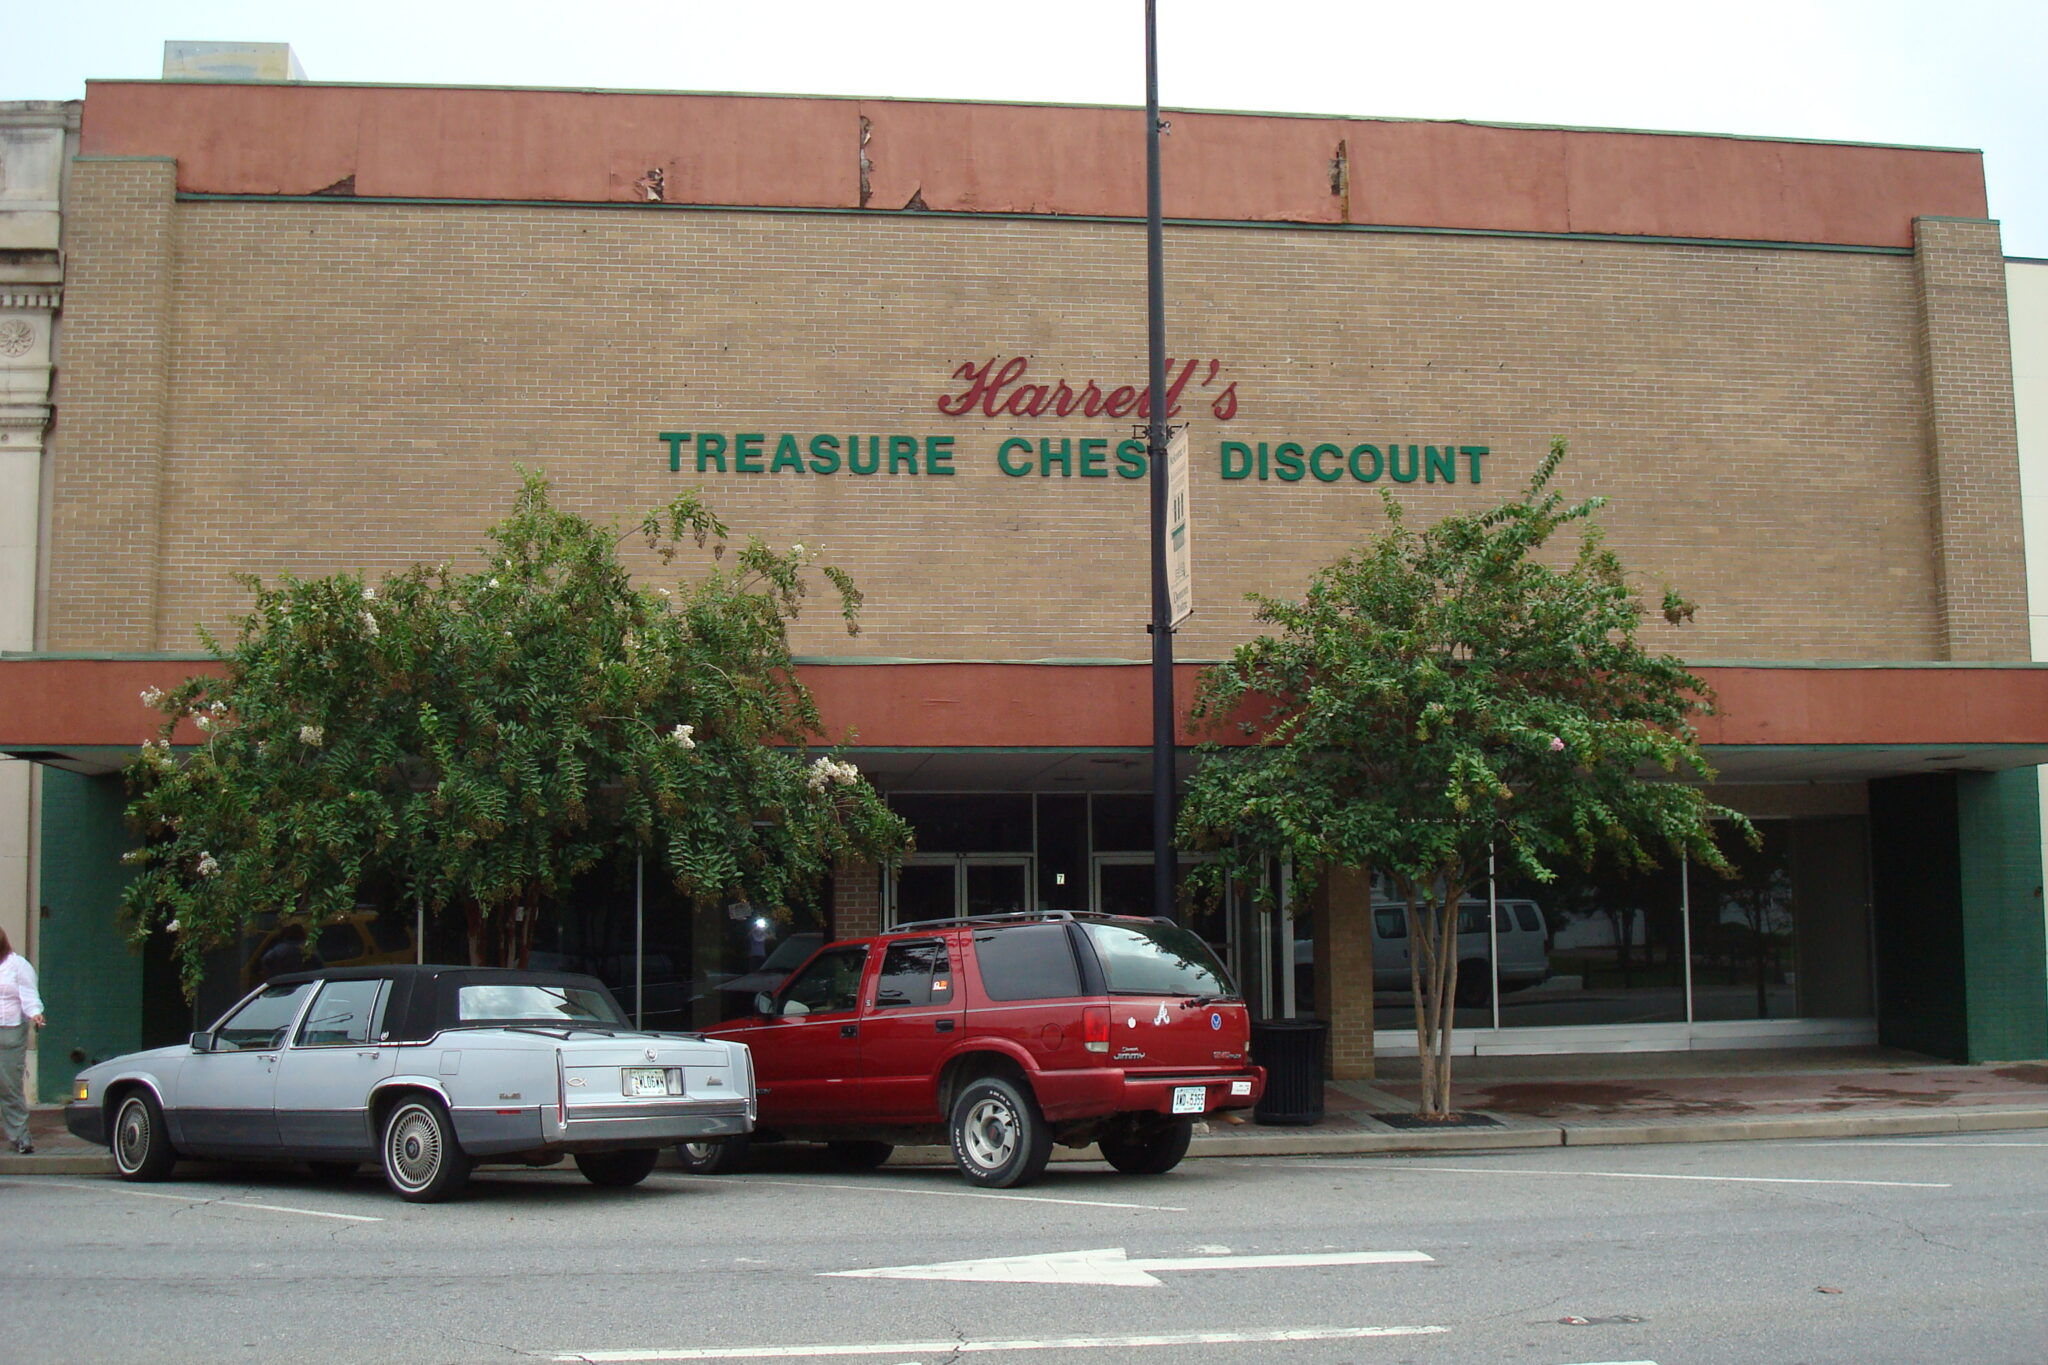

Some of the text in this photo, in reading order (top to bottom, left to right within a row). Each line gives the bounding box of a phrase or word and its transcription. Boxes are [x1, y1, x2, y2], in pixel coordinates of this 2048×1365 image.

[937, 356, 1237, 419] Harrell's
[659, 432, 956, 475] TREASURE
[997, 437, 1150, 478] CHES
[1220, 441, 1490, 484] DISCOUNT
